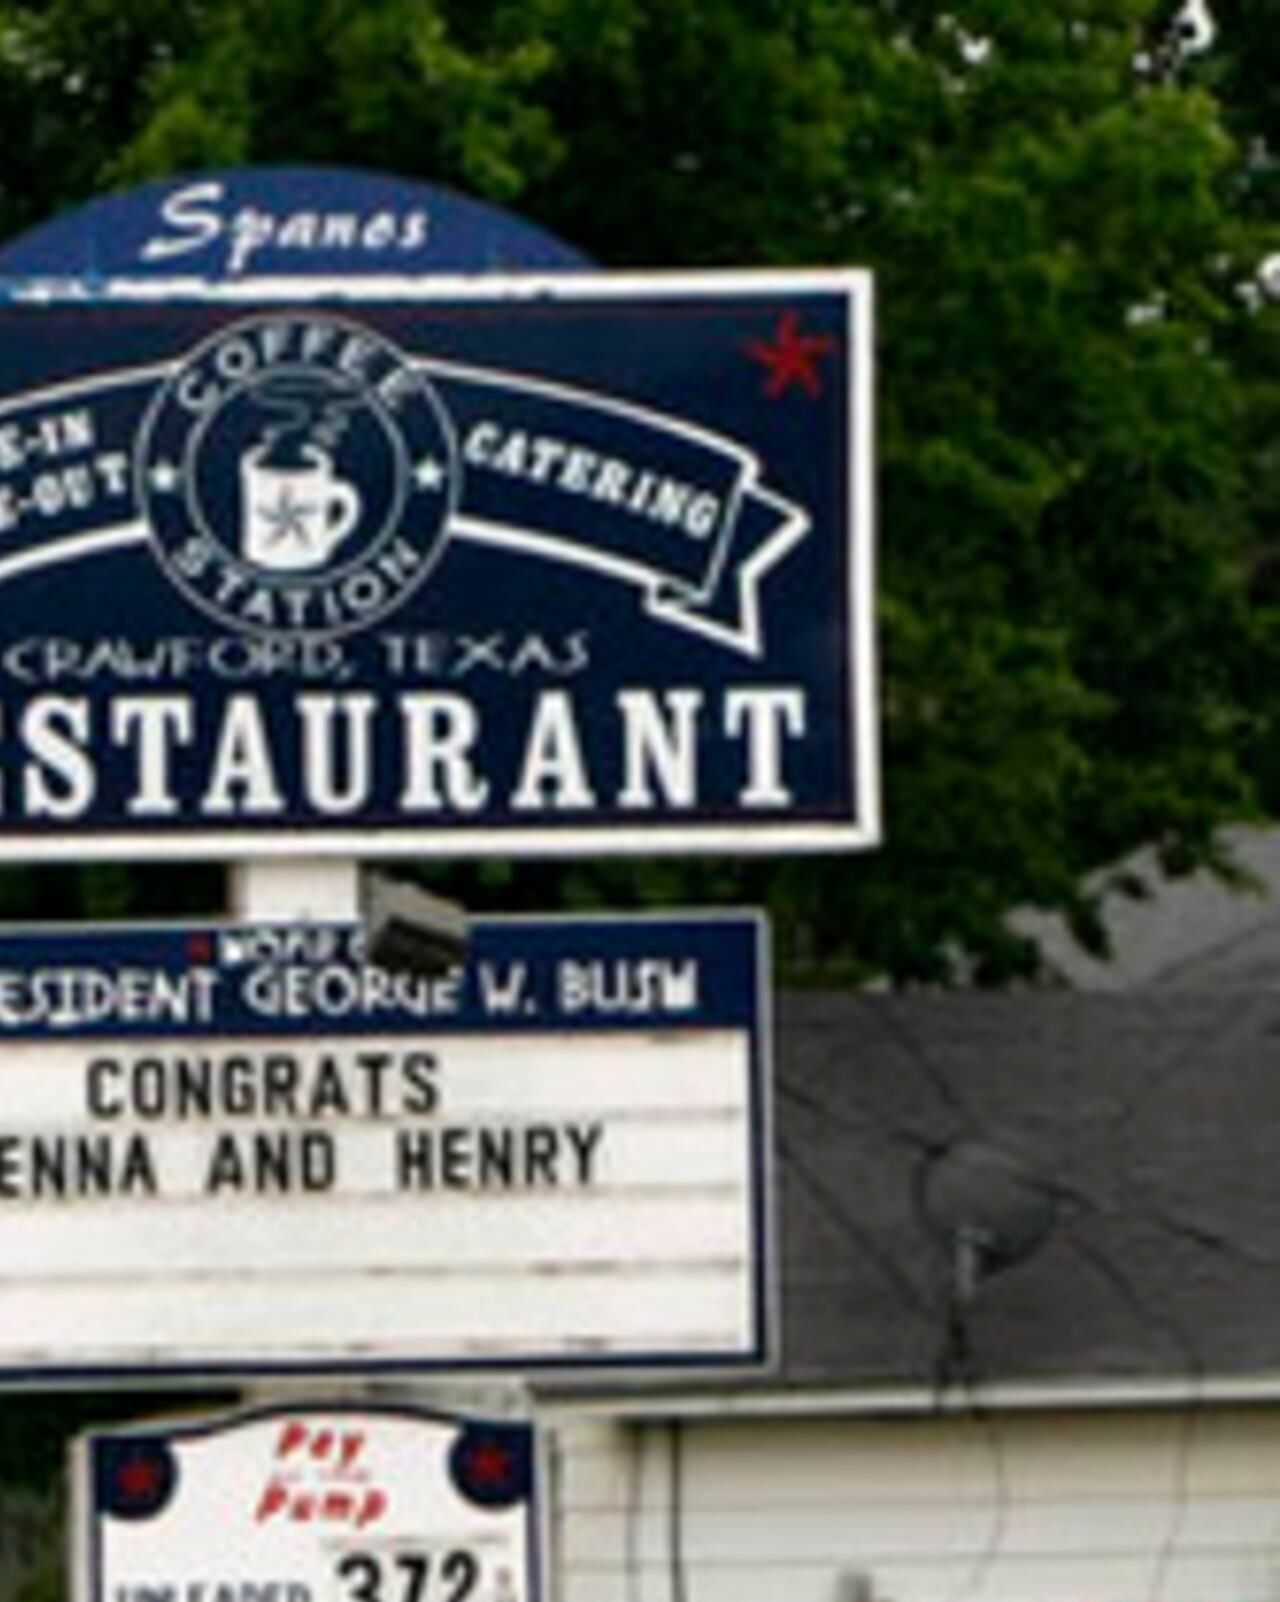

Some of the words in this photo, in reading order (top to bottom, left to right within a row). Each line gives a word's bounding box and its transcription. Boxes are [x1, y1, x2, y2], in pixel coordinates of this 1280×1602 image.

[176, 326, 426, 412] COFFEE
[462, 420, 720, 540] CATERING
[172, 535, 421, 627] STATION
[378, 630, 591, 676] TEXAS
[242, 962, 464, 1018] GEORGE
[478, 960, 537, 1016] W.
[85, 1052, 439, 1122] CONGRATS
[206, 1129, 337, 1194] AND
[396, 1121, 605, 1190] HENRY
[253, 1478, 388, 1529] Pump
